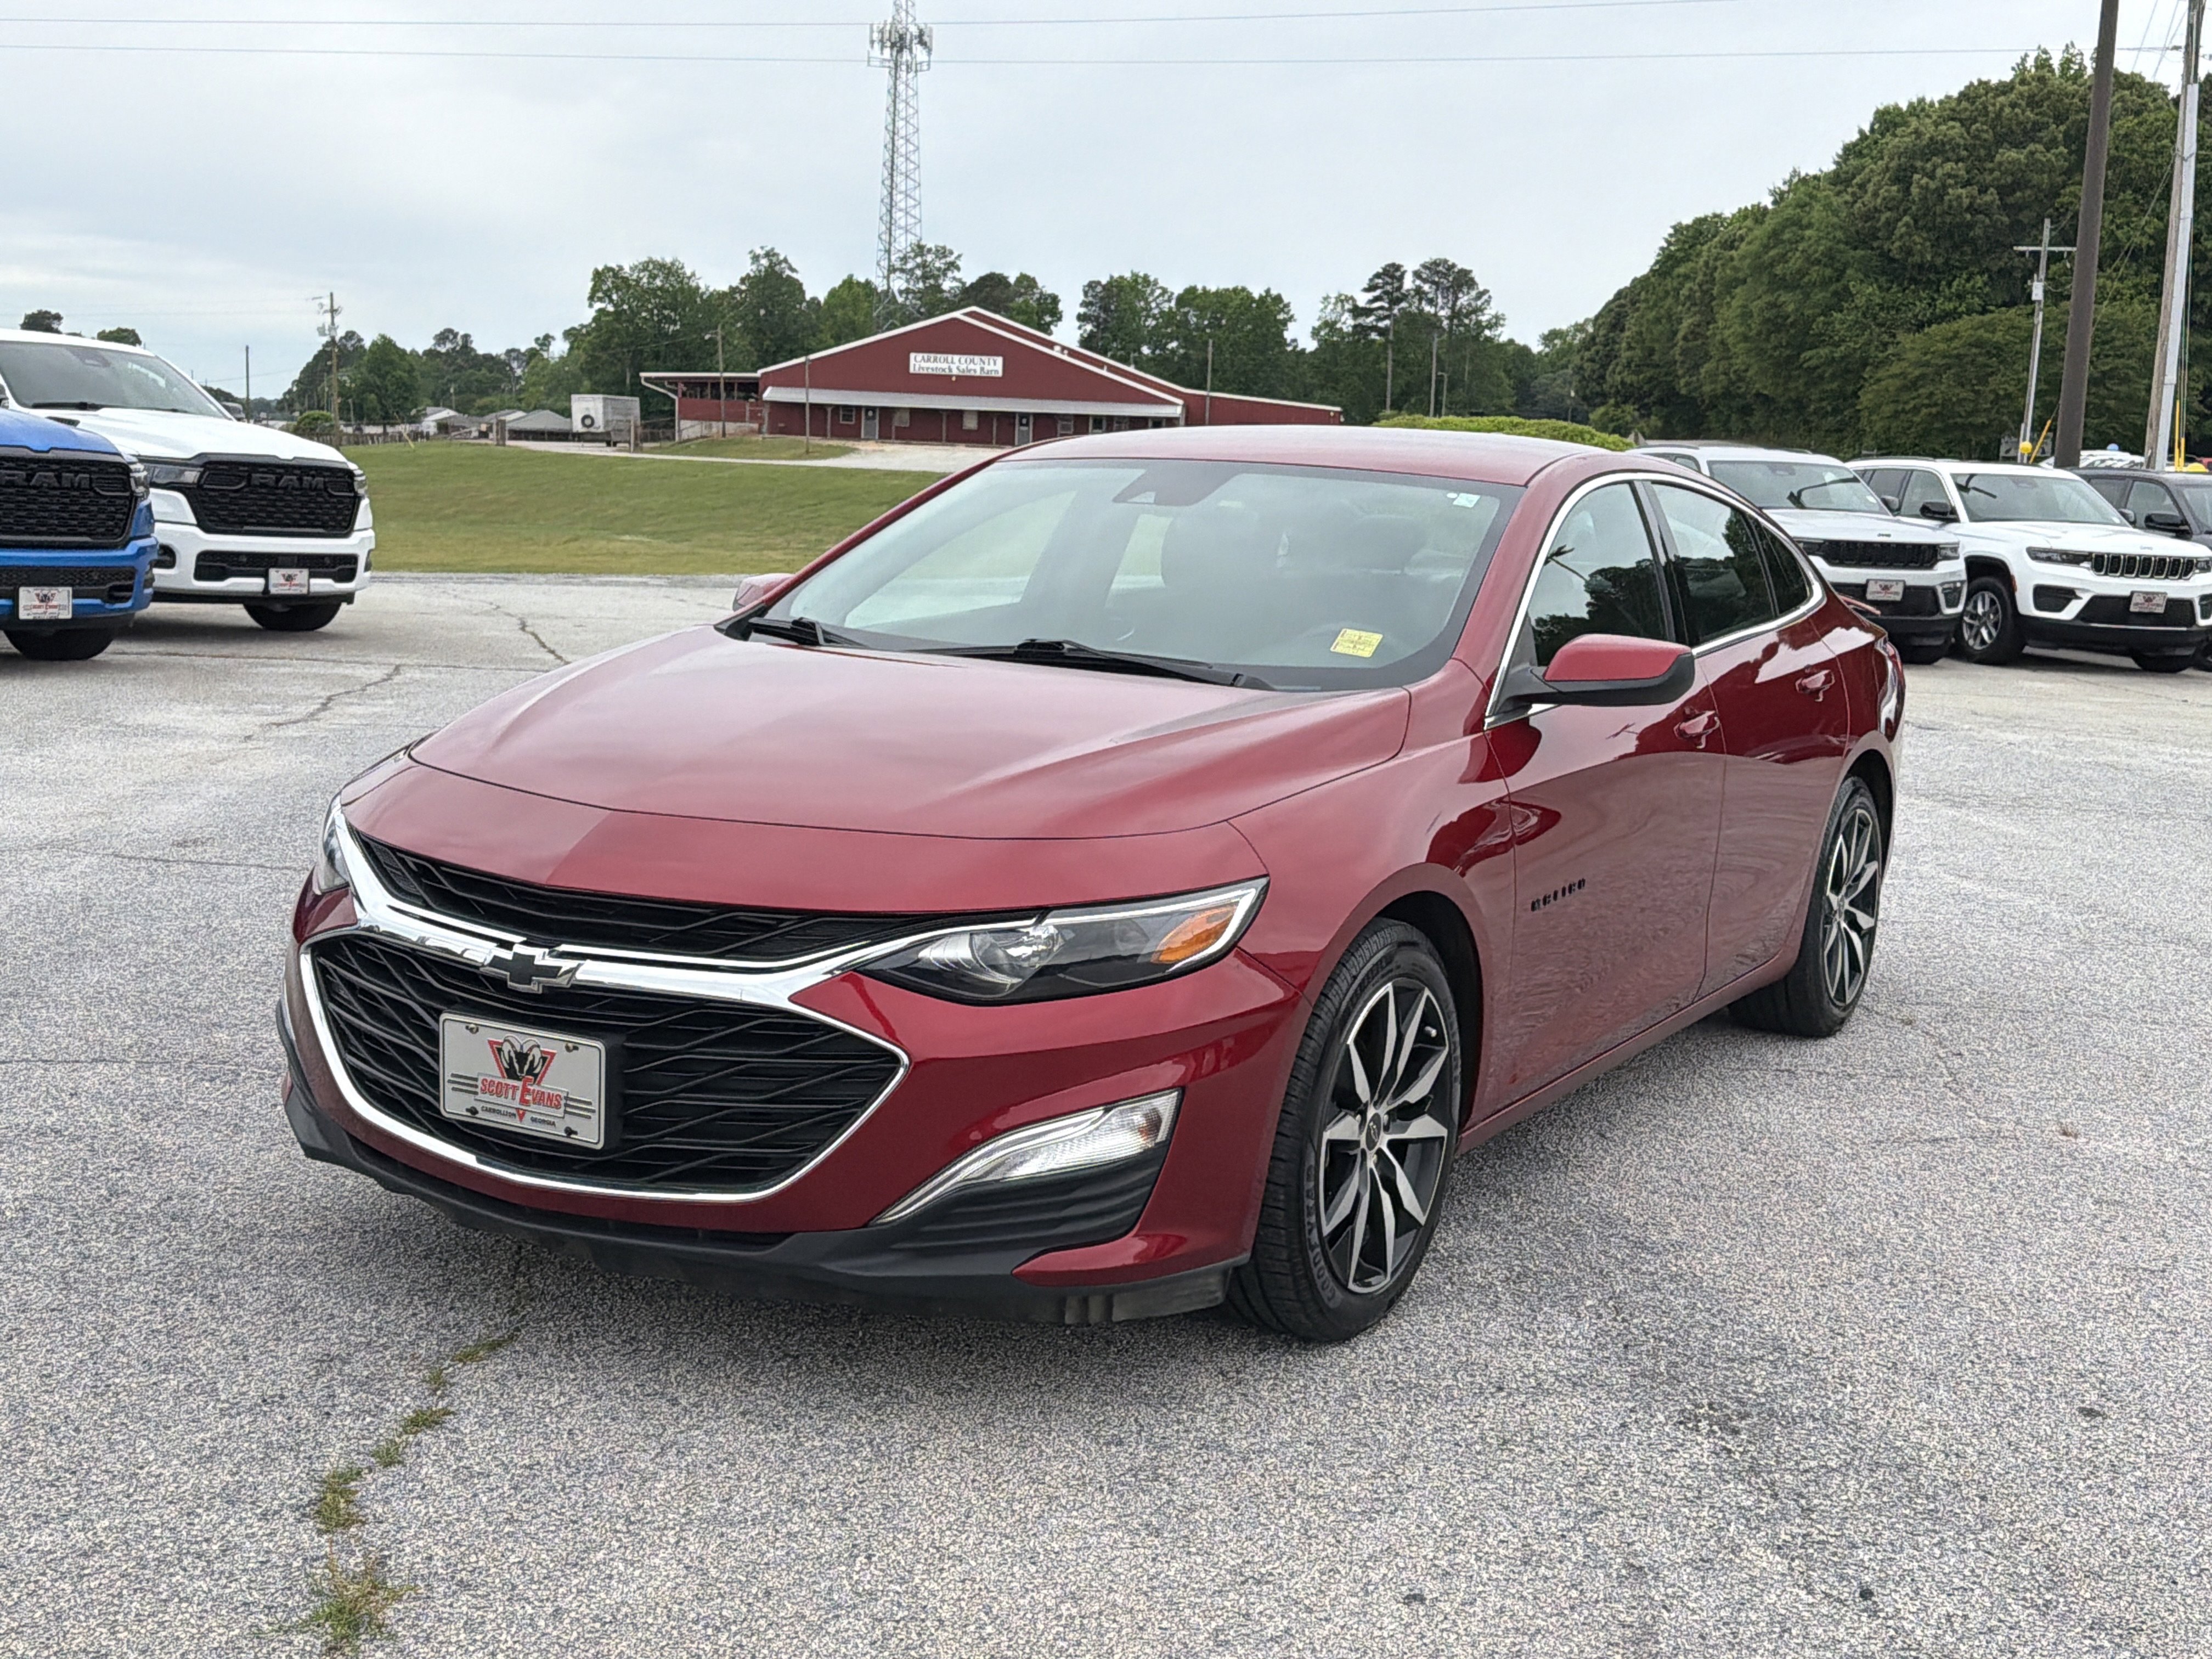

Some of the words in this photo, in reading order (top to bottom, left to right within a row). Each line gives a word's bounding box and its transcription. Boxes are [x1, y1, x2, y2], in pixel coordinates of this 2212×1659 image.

[913, 354, 956, 365] CARROLL
[958, 356, 998, 366] COUNTY
[912, 363, 953, 374] Livestock
[956, 364, 978, 374] Sales
[979, 366, 1000, 375] Barn
[0, 470, 91, 489] RAM
[251, 473, 325, 490] RAM
[479, 1077, 520, 1101] SCOTT
[518, 1075, 563, 1110] EVANS
